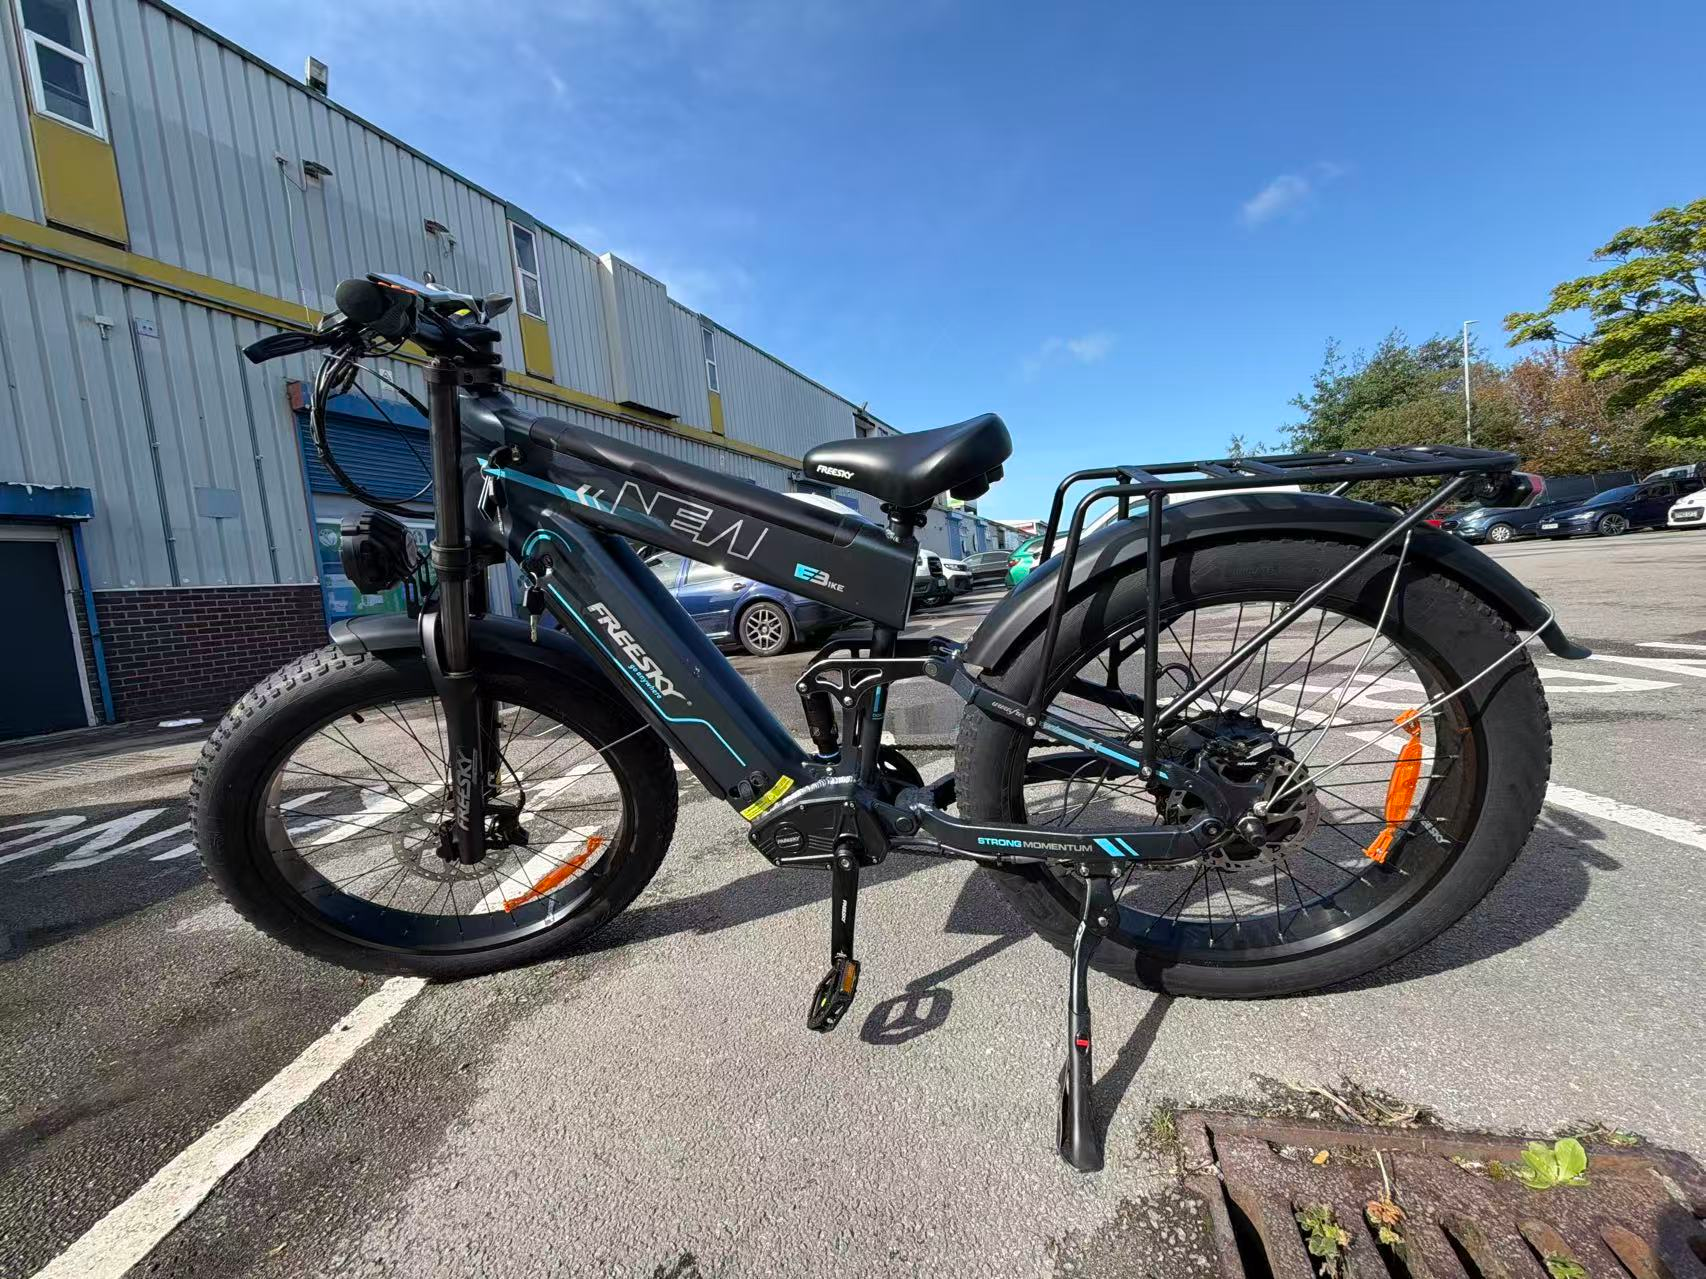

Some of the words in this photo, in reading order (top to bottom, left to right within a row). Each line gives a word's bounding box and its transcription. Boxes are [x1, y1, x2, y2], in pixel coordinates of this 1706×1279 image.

[816, 464, 855, 480] FREESKY
[587, 601, 686, 699] FREESKY
[627, 664, 638, 672] go
[636, 671, 662, 699] anywhere
[456, 749, 472, 831] FREESKY
[977, 837, 1022, 848] STRONG
[1023, 841, 1093, 852] MOMENTUM
